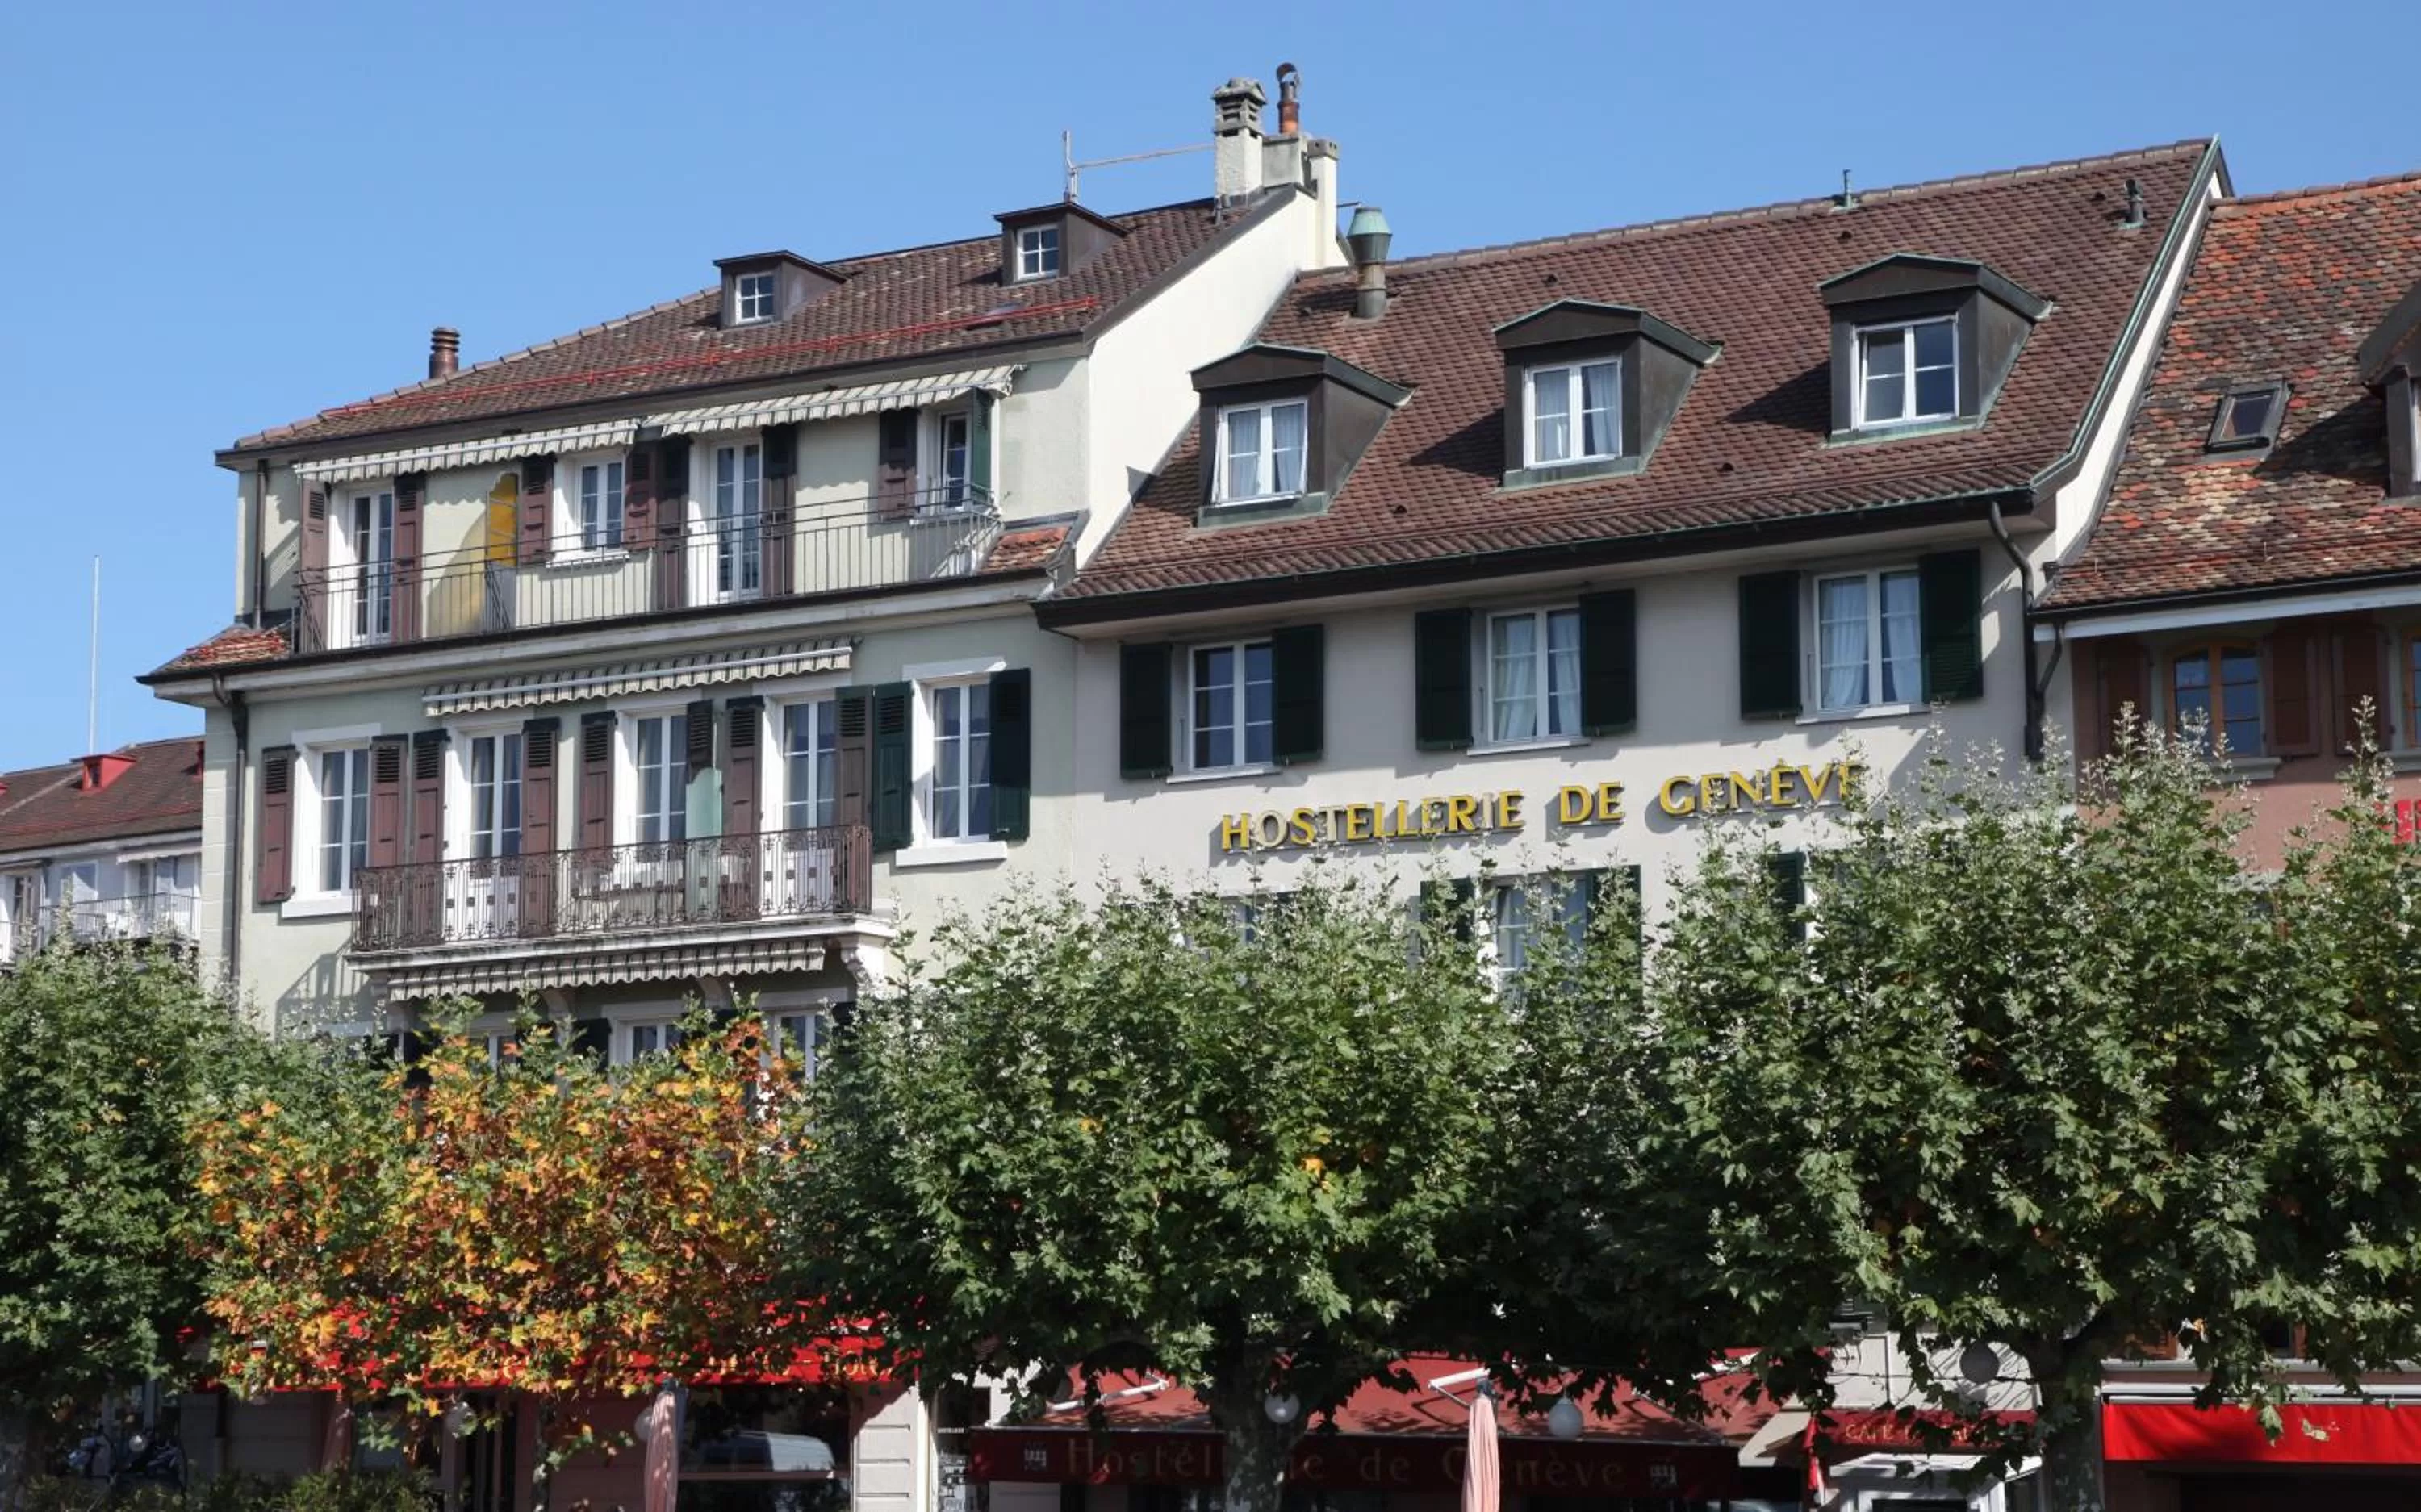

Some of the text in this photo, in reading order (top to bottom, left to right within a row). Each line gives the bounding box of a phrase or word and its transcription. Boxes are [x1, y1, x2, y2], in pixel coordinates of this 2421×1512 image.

[1221, 788, 1524, 851] HOSTELLERIE
[1559, 781, 1624, 825] DE
[1359, 1447, 1411, 1483] de
[1442, 1445, 1624, 1489] Gnève
